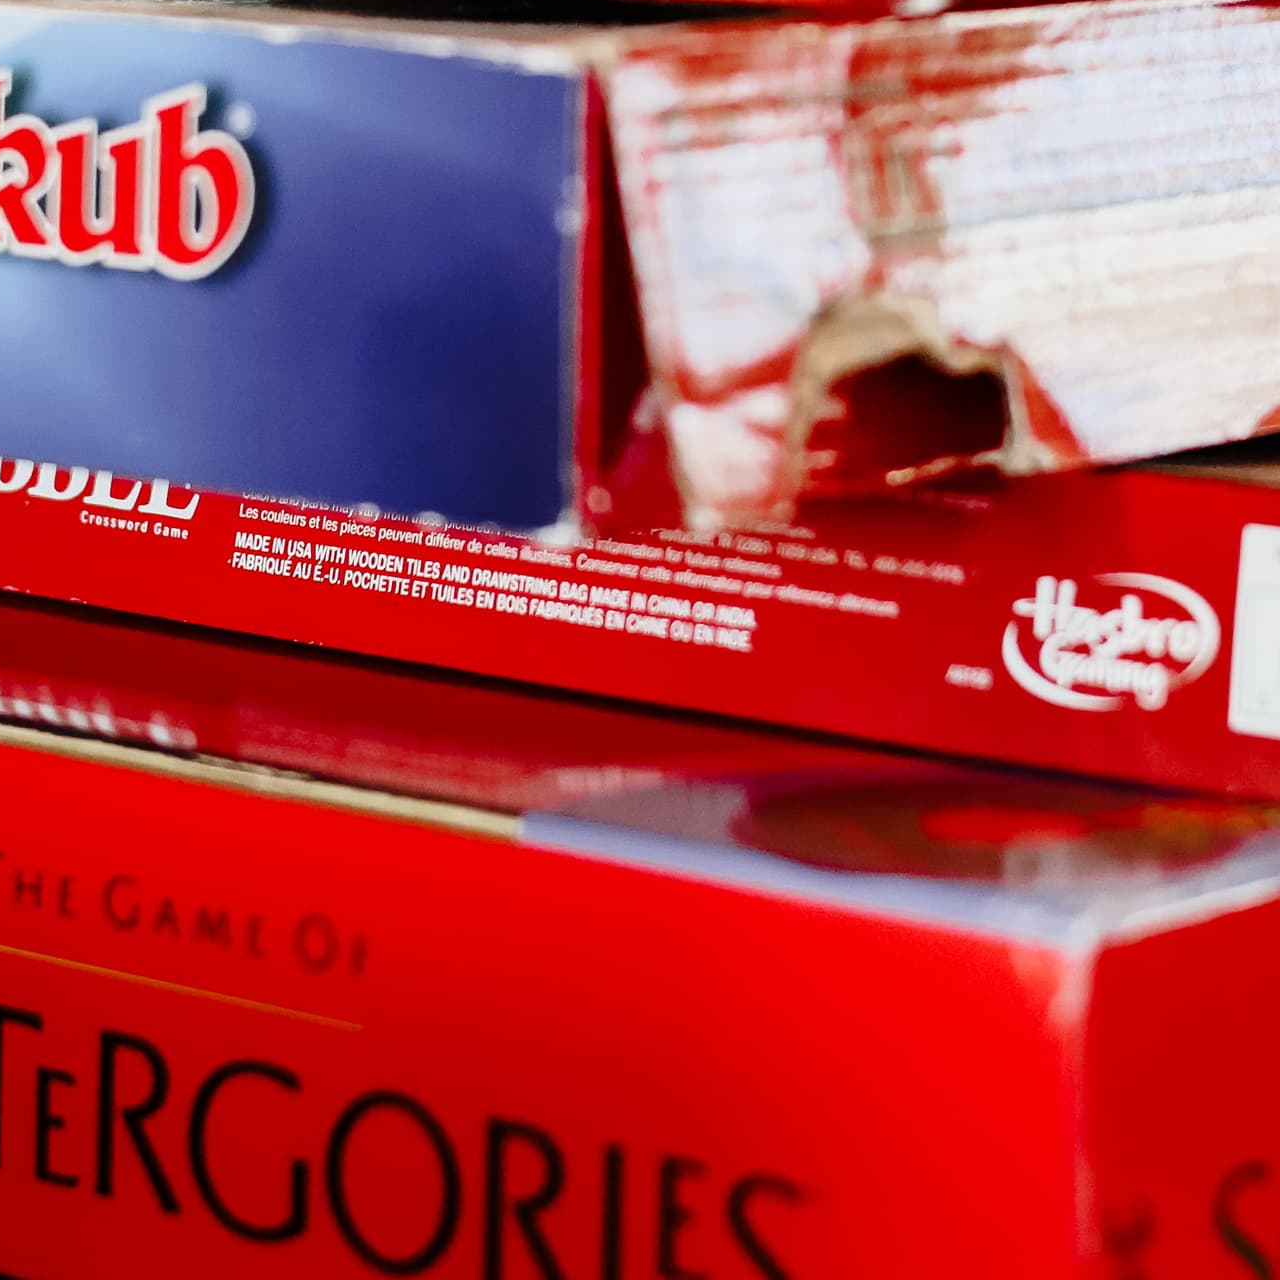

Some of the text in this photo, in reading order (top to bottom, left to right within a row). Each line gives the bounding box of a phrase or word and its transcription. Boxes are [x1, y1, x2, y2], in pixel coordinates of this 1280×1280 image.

[80, 510, 189, 540] Crossword Game
[239, 503, 259, 519] Les
[261, 508, 307, 528] couleurs
[309, 515, 321, 529] et
[322, 516, 338, 532] les
[339, 519, 377, 538] pièces
[378, 525, 423, 544] peuvent
[468, 537, 482, 554] de
[232, 551, 292, 577] FABRIQUÉ
[293, 562, 312, 580] AU
[343, 570, 410, 596] POCHETTE
[411, 580, 429, 598] ET
[430, 583, 474, 606] TUILES
[476, 590, 495, 609] EN
[496, 593, 528, 614] BOIS
[529, 598, 605, 628] FABRIQUÉS
[605, 609, 626, 630] EN
[234, 531, 270, 554] MADE
[271, 537, 285, 555] IN
[287, 539, 312, 560] USA
[314, 543, 346, 565] WITH
[347, 549, 403, 573] WOODEN
[406, 557, 441, 580] TILES
[442, 563, 471, 584] AND
[471, 567, 558, 598] DRAWSTRING
[559, 580, 588, 603] BAG
[589, 585, 630, 610] MADE
[631, 592, 647, 612] IN
[648, 594, 691, 618] CHINA
[1012, 575, 1200, 661] Hasbro
[1039, 632, 1170, 711] Gaming
[102, 873, 268, 960] GAME
[293, 911, 370, 978] OF
